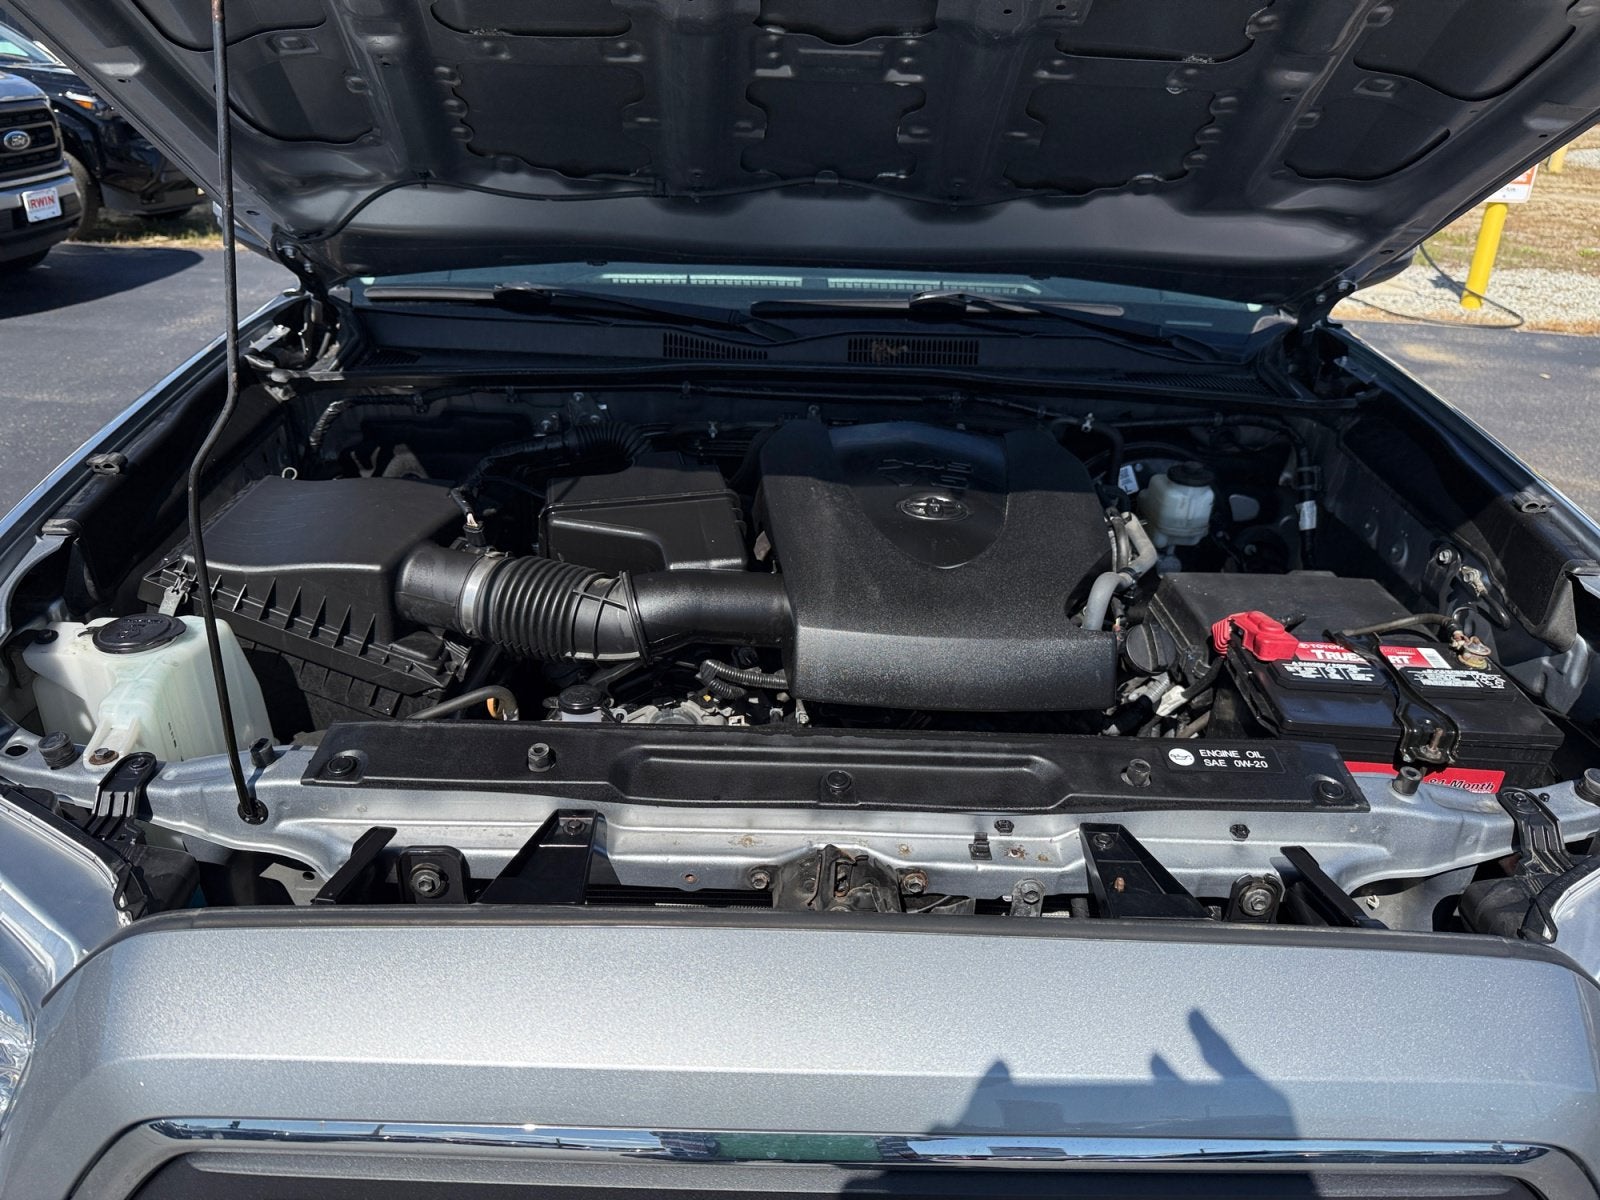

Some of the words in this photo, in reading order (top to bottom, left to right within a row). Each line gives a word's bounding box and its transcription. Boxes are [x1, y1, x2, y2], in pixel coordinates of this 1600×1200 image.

[1199, 749, 1240, 758] ENGINE
[1245, 750, 1265, 759] OIL
[1203, 759, 1227, 767] SAE
[1233, 759, 1268, 768] 0W-20
[1450, 780, 1495, 791] Month
